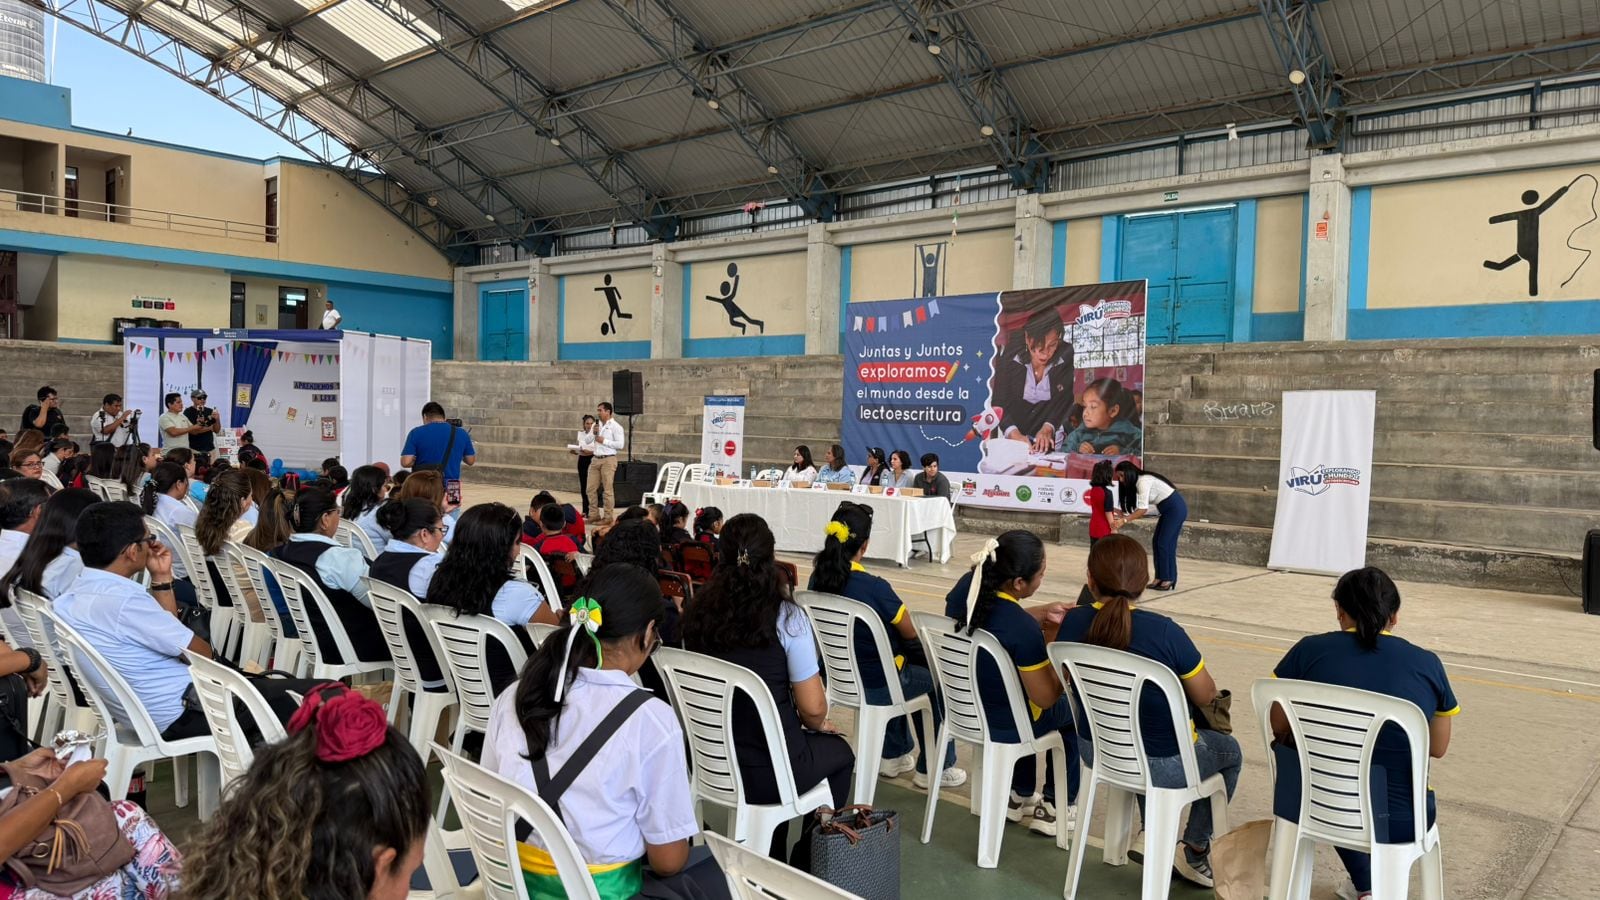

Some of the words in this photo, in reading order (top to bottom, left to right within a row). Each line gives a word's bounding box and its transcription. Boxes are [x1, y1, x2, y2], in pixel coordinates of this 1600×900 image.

[1077, 307, 1103, 324] VIRÚ
[859, 345, 901, 358] Juntas
[904, 347, 912, 360] y
[916, 343, 963, 357] Juntos
[860, 363, 947, 381] exploramos
[857, 387, 867, 398] el
[870, 387, 912, 399] mundo
[915, 387, 954, 399] desde
[959, 387, 969, 399] la
[860, 405, 961, 422] lectoescritura
[1286, 471, 1322, 488] VIRÚ
